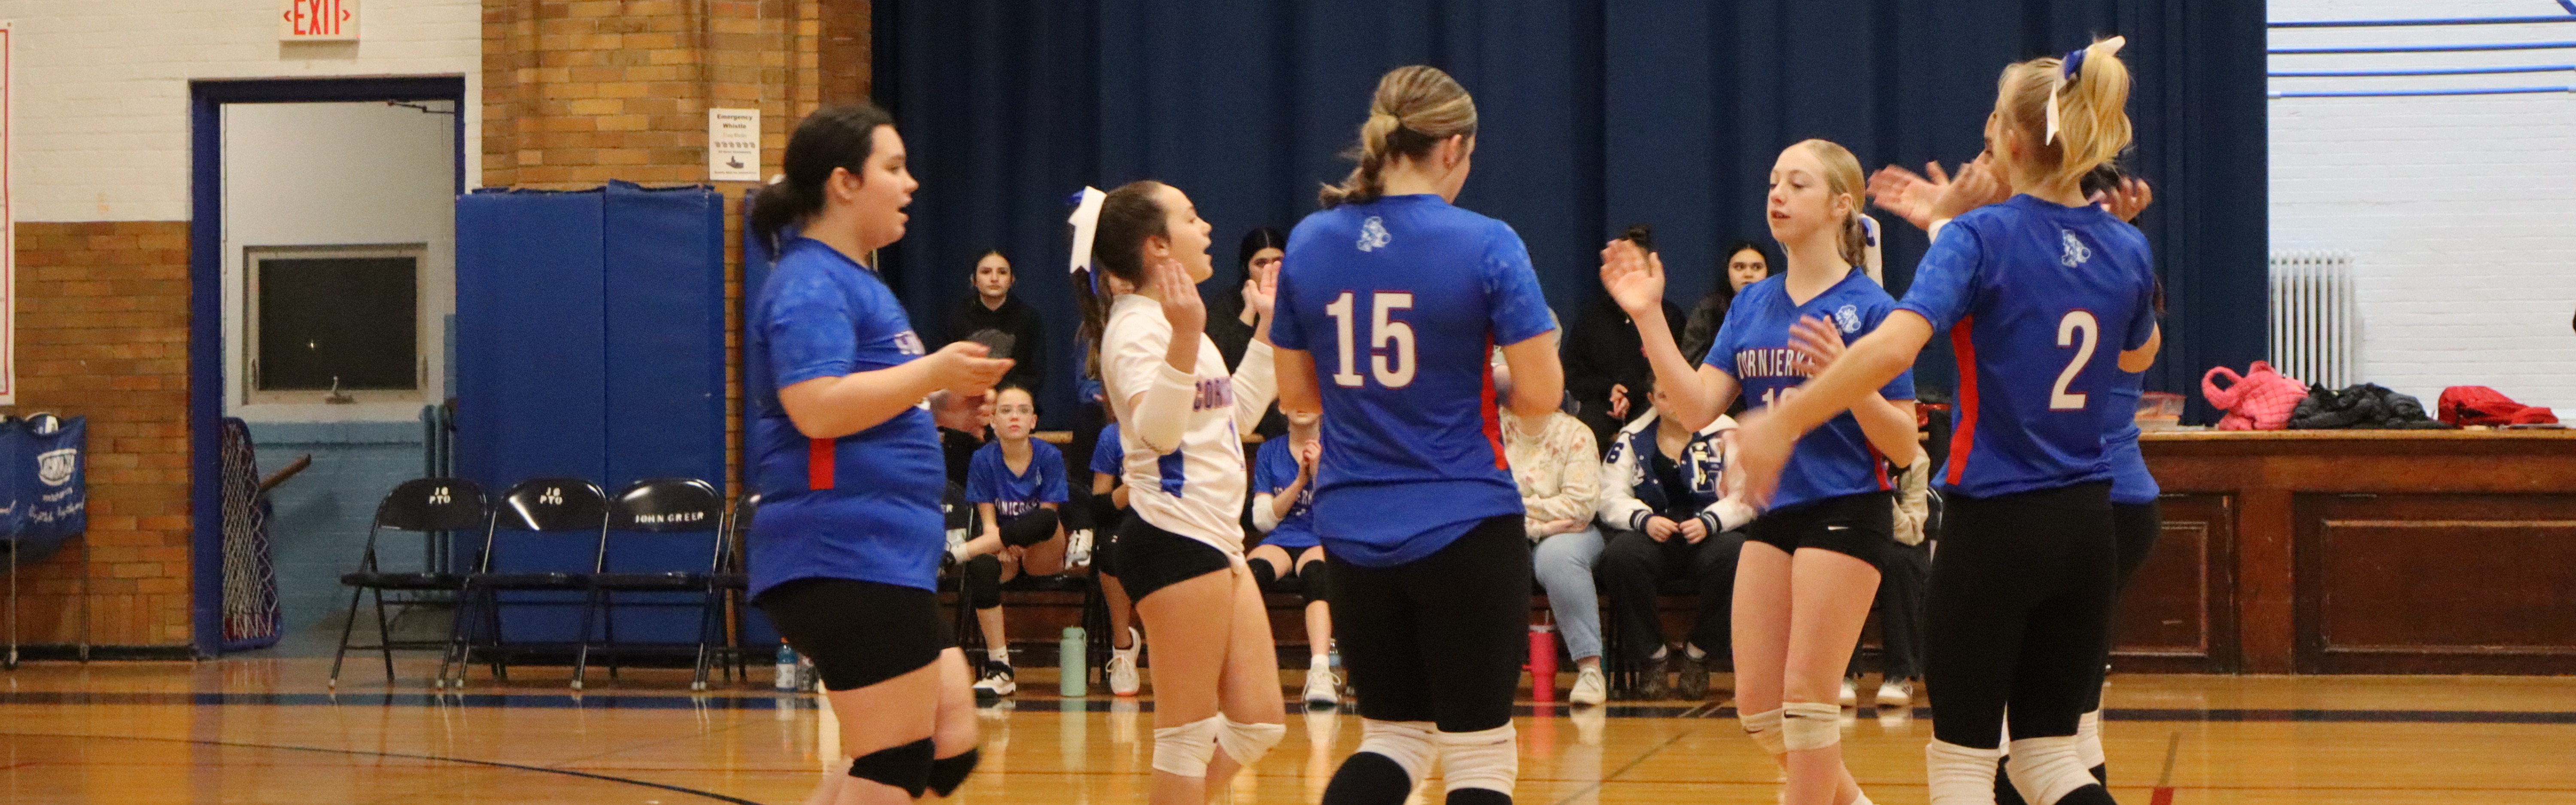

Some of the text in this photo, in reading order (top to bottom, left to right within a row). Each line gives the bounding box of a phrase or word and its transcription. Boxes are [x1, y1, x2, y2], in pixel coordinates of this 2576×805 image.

[294, 0, 341, 35] EXIT
[1324, 290, 1416, 389] 15
[2048, 308, 2100, 411] 2
[429, 495, 451, 504] PTO
[540, 495, 562, 505] PTO
[635, 511, 704, 523] JOHN GREER
